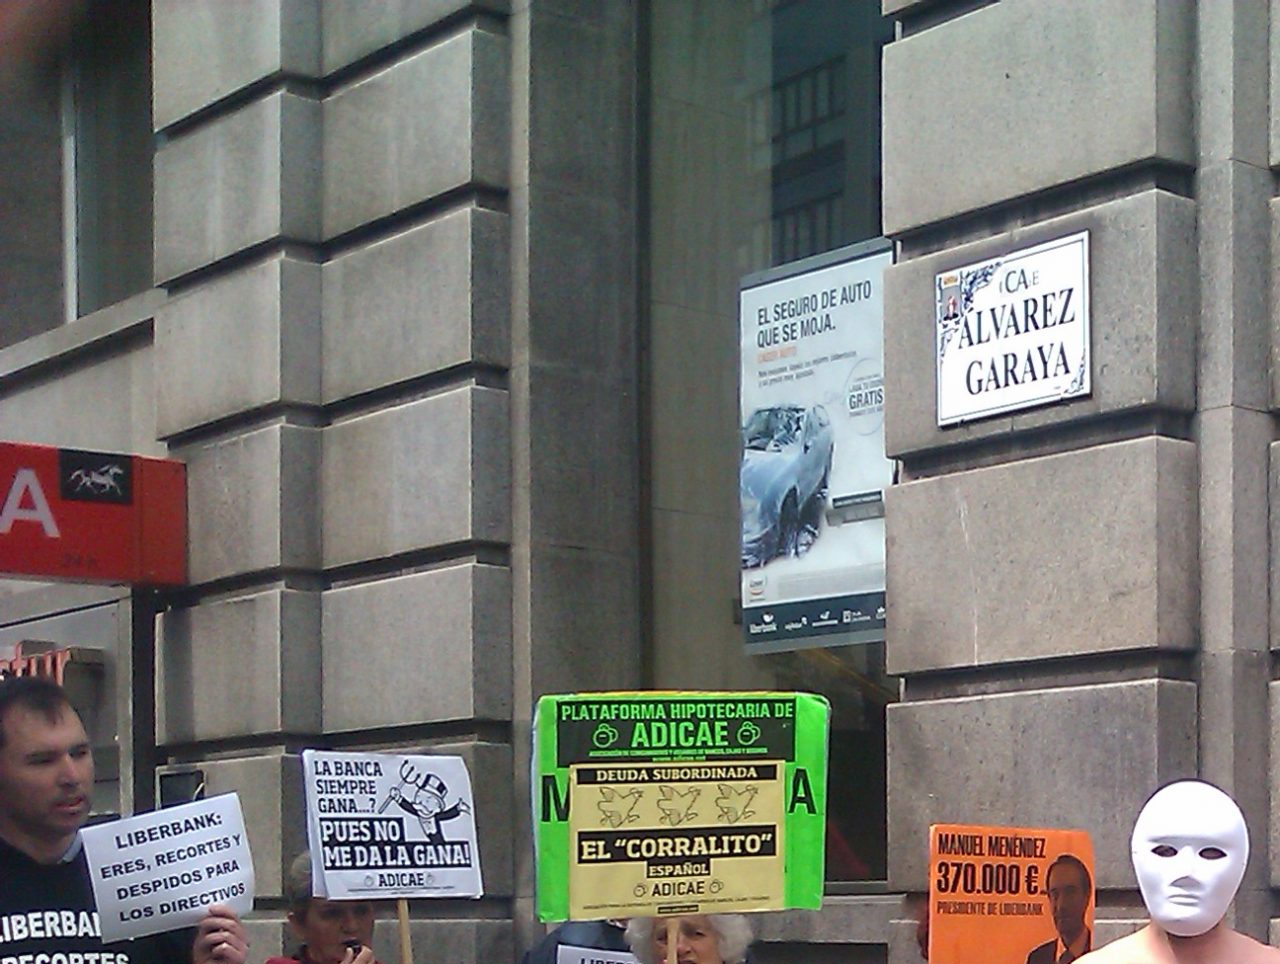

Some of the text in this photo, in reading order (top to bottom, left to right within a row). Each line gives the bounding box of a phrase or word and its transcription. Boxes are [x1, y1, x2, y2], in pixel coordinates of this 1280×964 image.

[758, 280, 872, 326] EL SEGURO DE AUTO
[958, 287, 1076, 349] ÁLVAREZ
[757, 313, 836, 348] QUE SE MOJA.
[966, 341, 1071, 395] GARAYA
[849, 388, 883, 410] GRATIS
[561, 702, 794, 721] PLATAFORMA HIPOTECARIA DE
[631, 721, 729, 748] ADICAE
[314, 760, 383, 777] LA BANCA
[596, 766, 758, 782] DEUDA SUBORDINADA
[316, 779, 377, 795] SIEMPRE
[115, 813, 223, 850] LIBERBANK:
[322, 820, 400, 842] PUES NO
[100, 833, 242, 880] ERES, RECORTES Y
[324, 844, 471, 867] ME DA LA GANA!
[580, 840, 612, 861] EL
[938, 832, 1046, 858] MANUEL MENÉNDEZ
[117, 859, 240, 901] DESPIDOS PARA
[378, 873, 425, 888] ADICAE
[649, 861, 709, 877] ESPAÑOL
[937, 861, 1021, 895] 370.000
[652, 881, 706, 897] ADICAE
[120, 882, 246, 923] LOS DIRECTIVOS
[937, 900, 986, 916] PRESIDENTE
